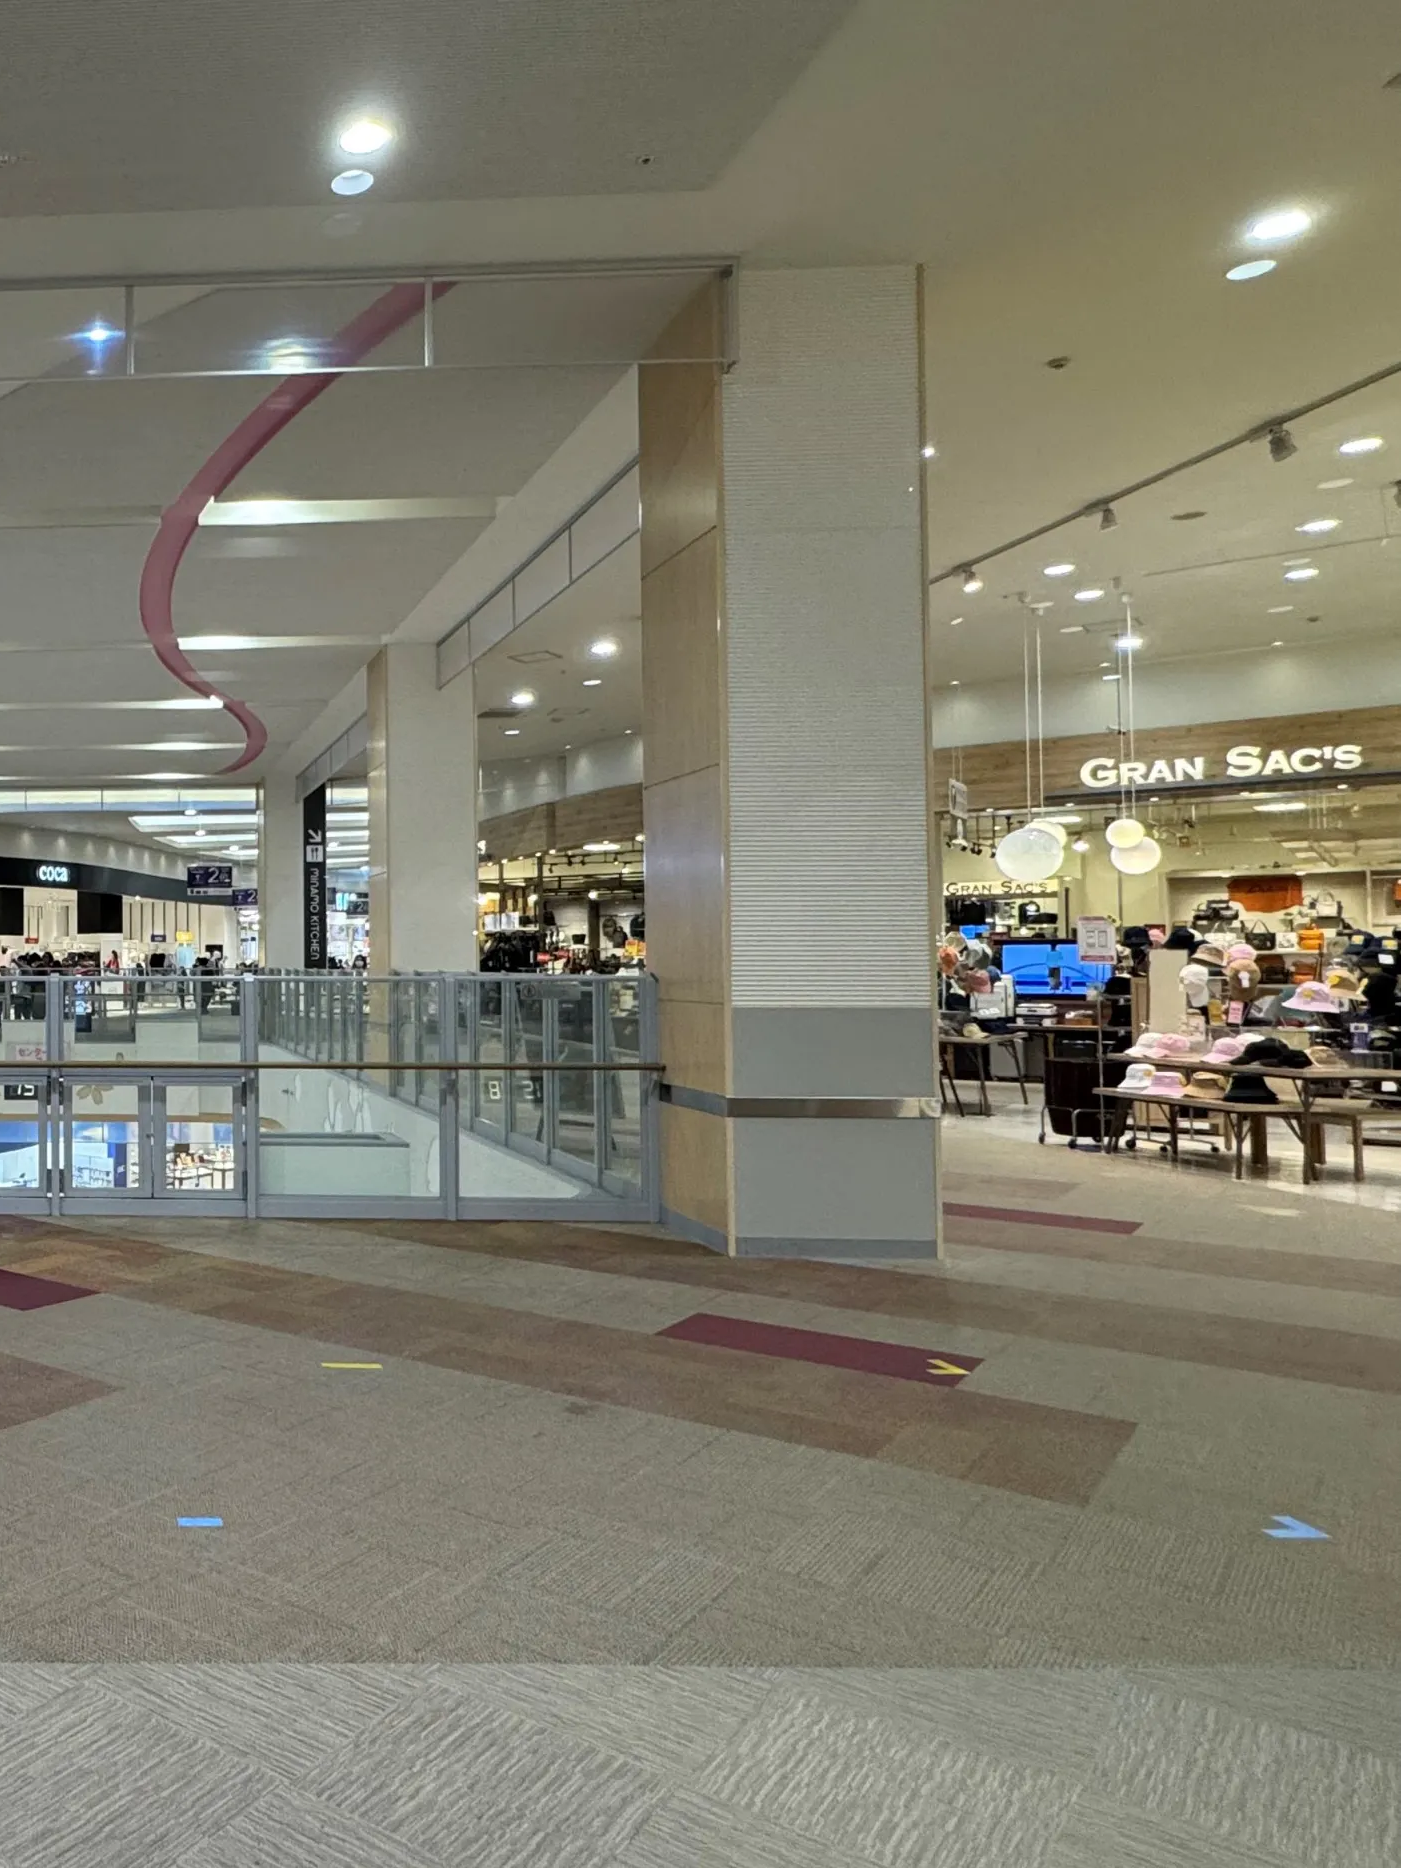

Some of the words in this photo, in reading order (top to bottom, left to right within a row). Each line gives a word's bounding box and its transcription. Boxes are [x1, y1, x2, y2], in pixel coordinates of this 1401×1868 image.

[1079, 756, 1205, 788] GRAN
[1225, 744, 1364, 778] SAC'S
[39, 865, 69, 882] coca
[945, 882, 993, 895] GRAN
